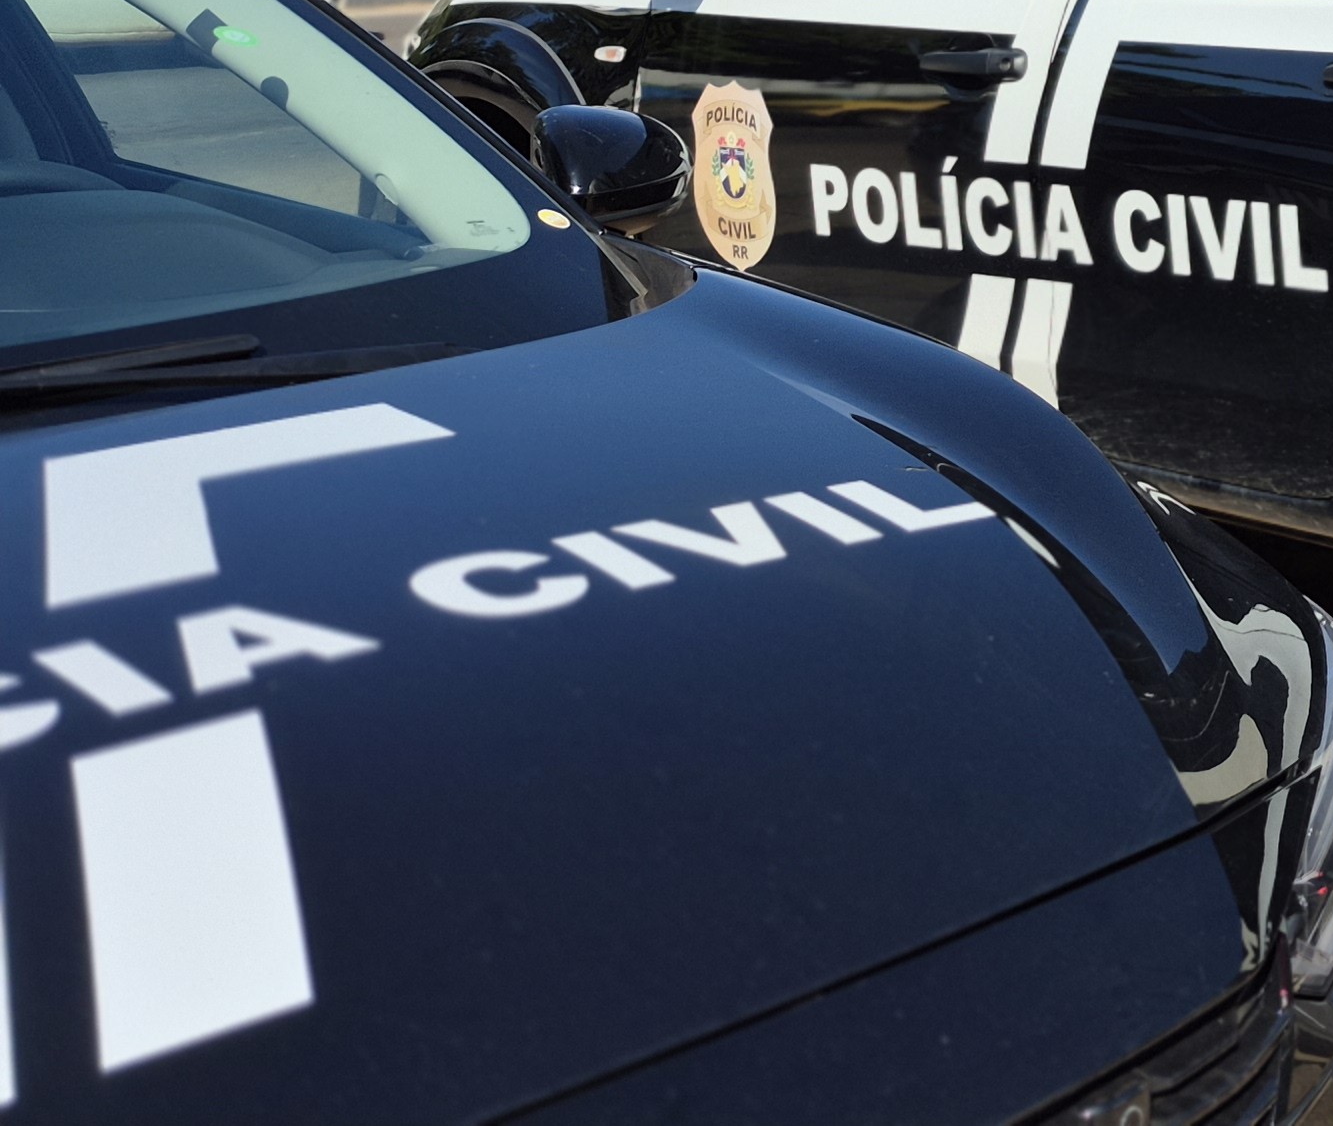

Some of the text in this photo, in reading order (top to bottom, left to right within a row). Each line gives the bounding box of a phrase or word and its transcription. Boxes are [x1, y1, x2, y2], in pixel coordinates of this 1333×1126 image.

[706, 103, 758, 132] POLÍCIA
[718, 217, 756, 240] CIVIL
[809, 157, 1329, 292] POLÍCIA CIVIL
[732, 244, 749, 260] RR
[0, 478, 998, 750] IA CIVIL
